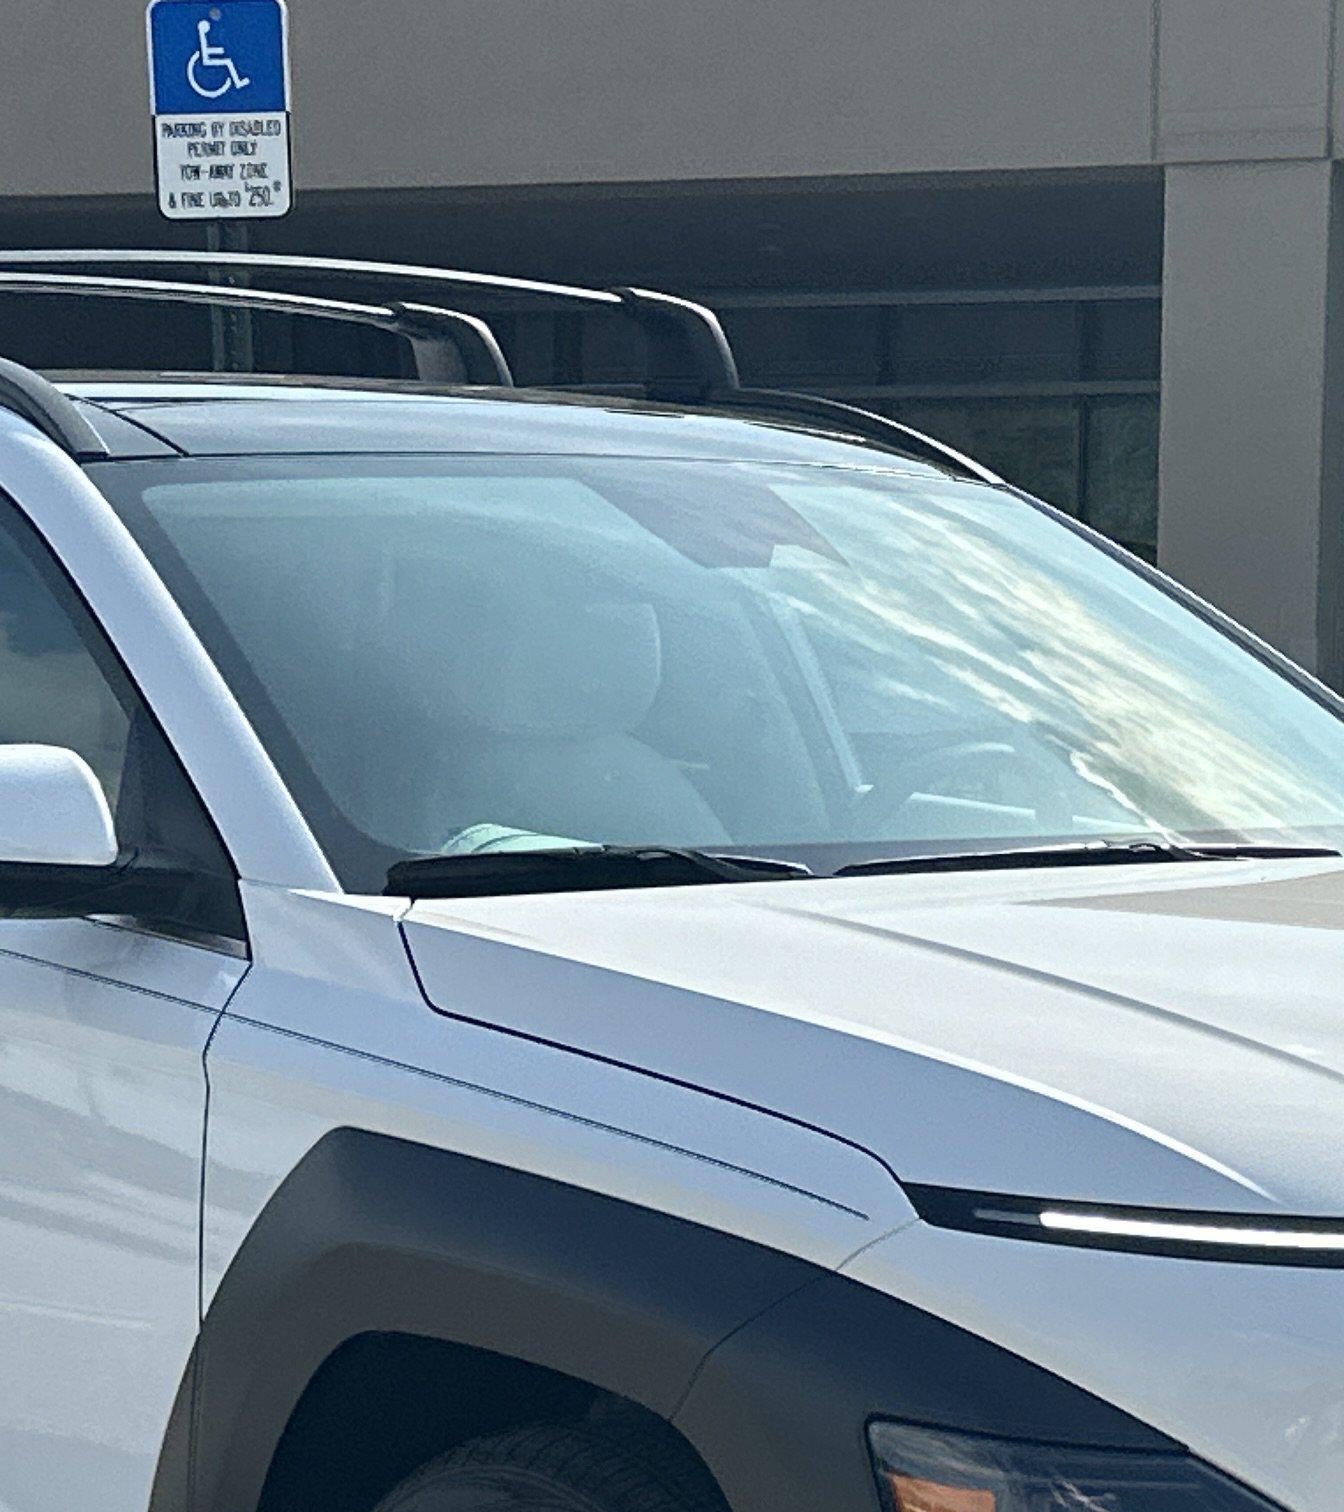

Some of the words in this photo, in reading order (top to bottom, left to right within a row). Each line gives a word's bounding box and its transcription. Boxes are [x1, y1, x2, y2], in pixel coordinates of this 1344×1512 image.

[161, 122, 206, 138] PARKING
[211, 121, 224, 137] BY
[229, 119, 281, 137] DISABLED
[187, 141, 225, 157] PERMIT
[230, 139, 257, 155] ONLY
[180, 163, 235, 180] TOW-AWAY
[240, 162, 268, 180] ZONE
[181, 192, 205, 209] FINE
